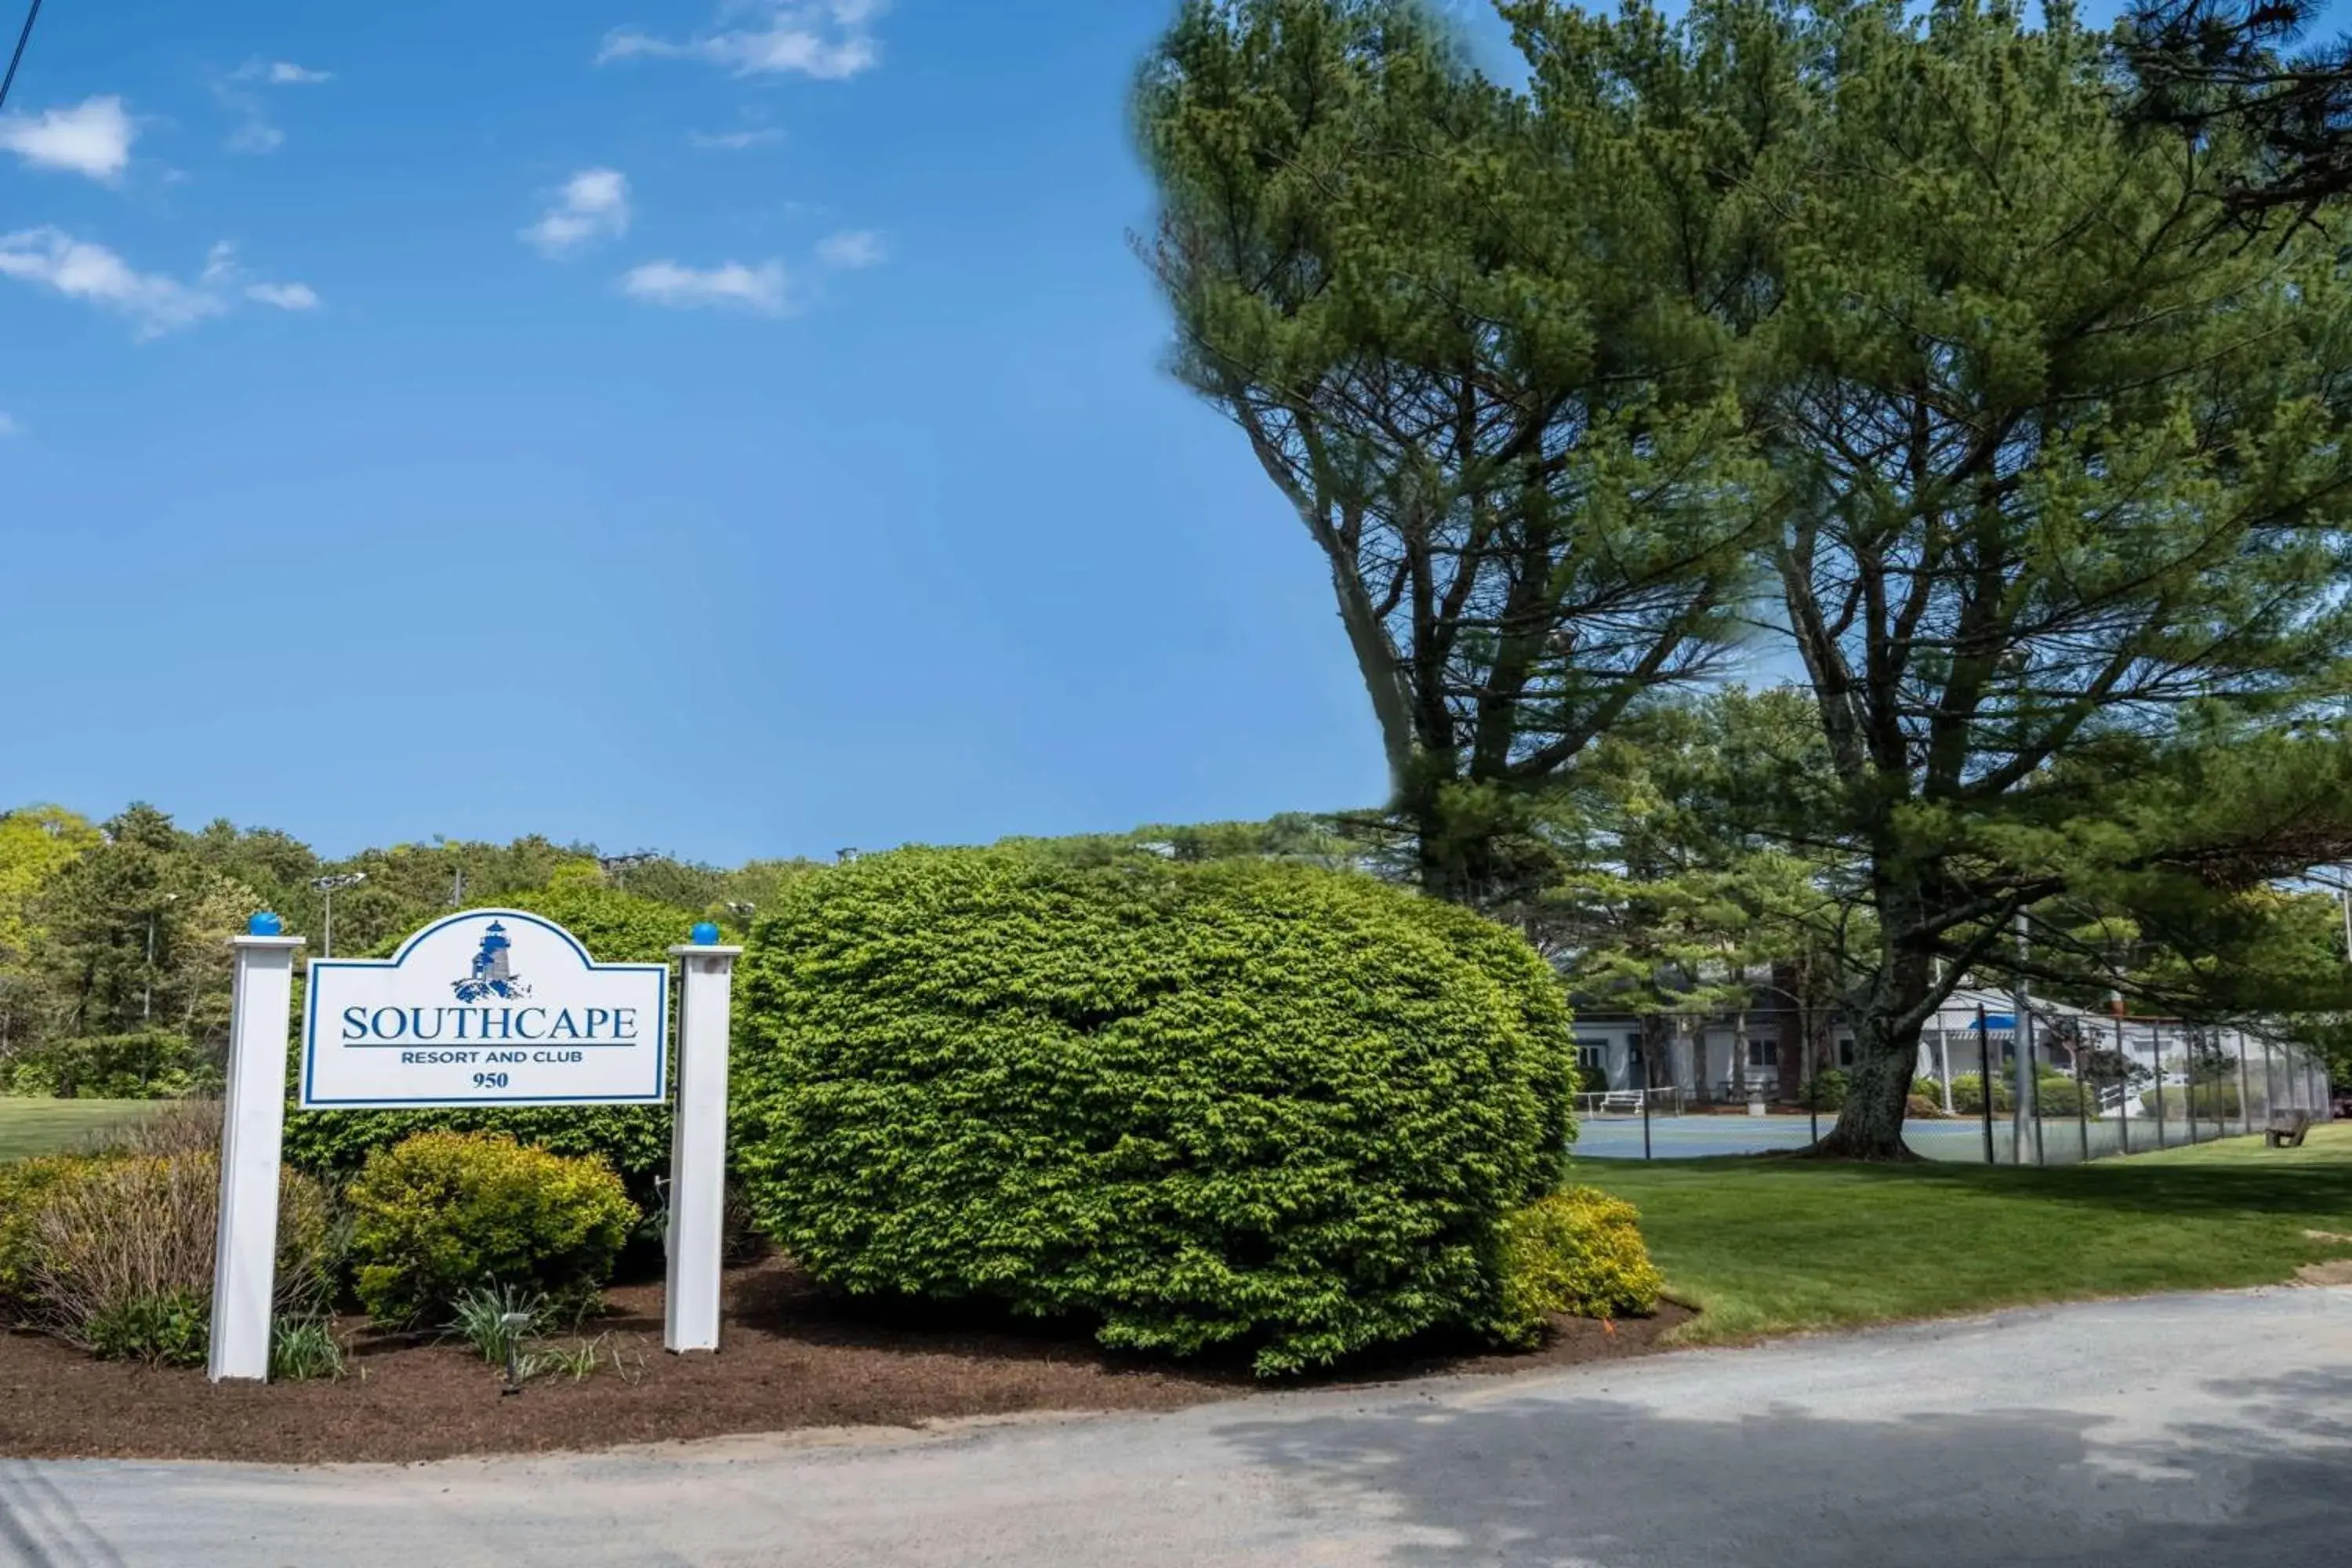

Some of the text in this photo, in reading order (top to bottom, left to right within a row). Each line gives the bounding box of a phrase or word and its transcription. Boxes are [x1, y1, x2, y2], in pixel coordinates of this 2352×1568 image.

[343, 1006, 638, 1040] SOUTHCAPE
[401, 1051, 583, 1064] RESORT AND CLUB
[472, 1073, 509, 1088] 950
